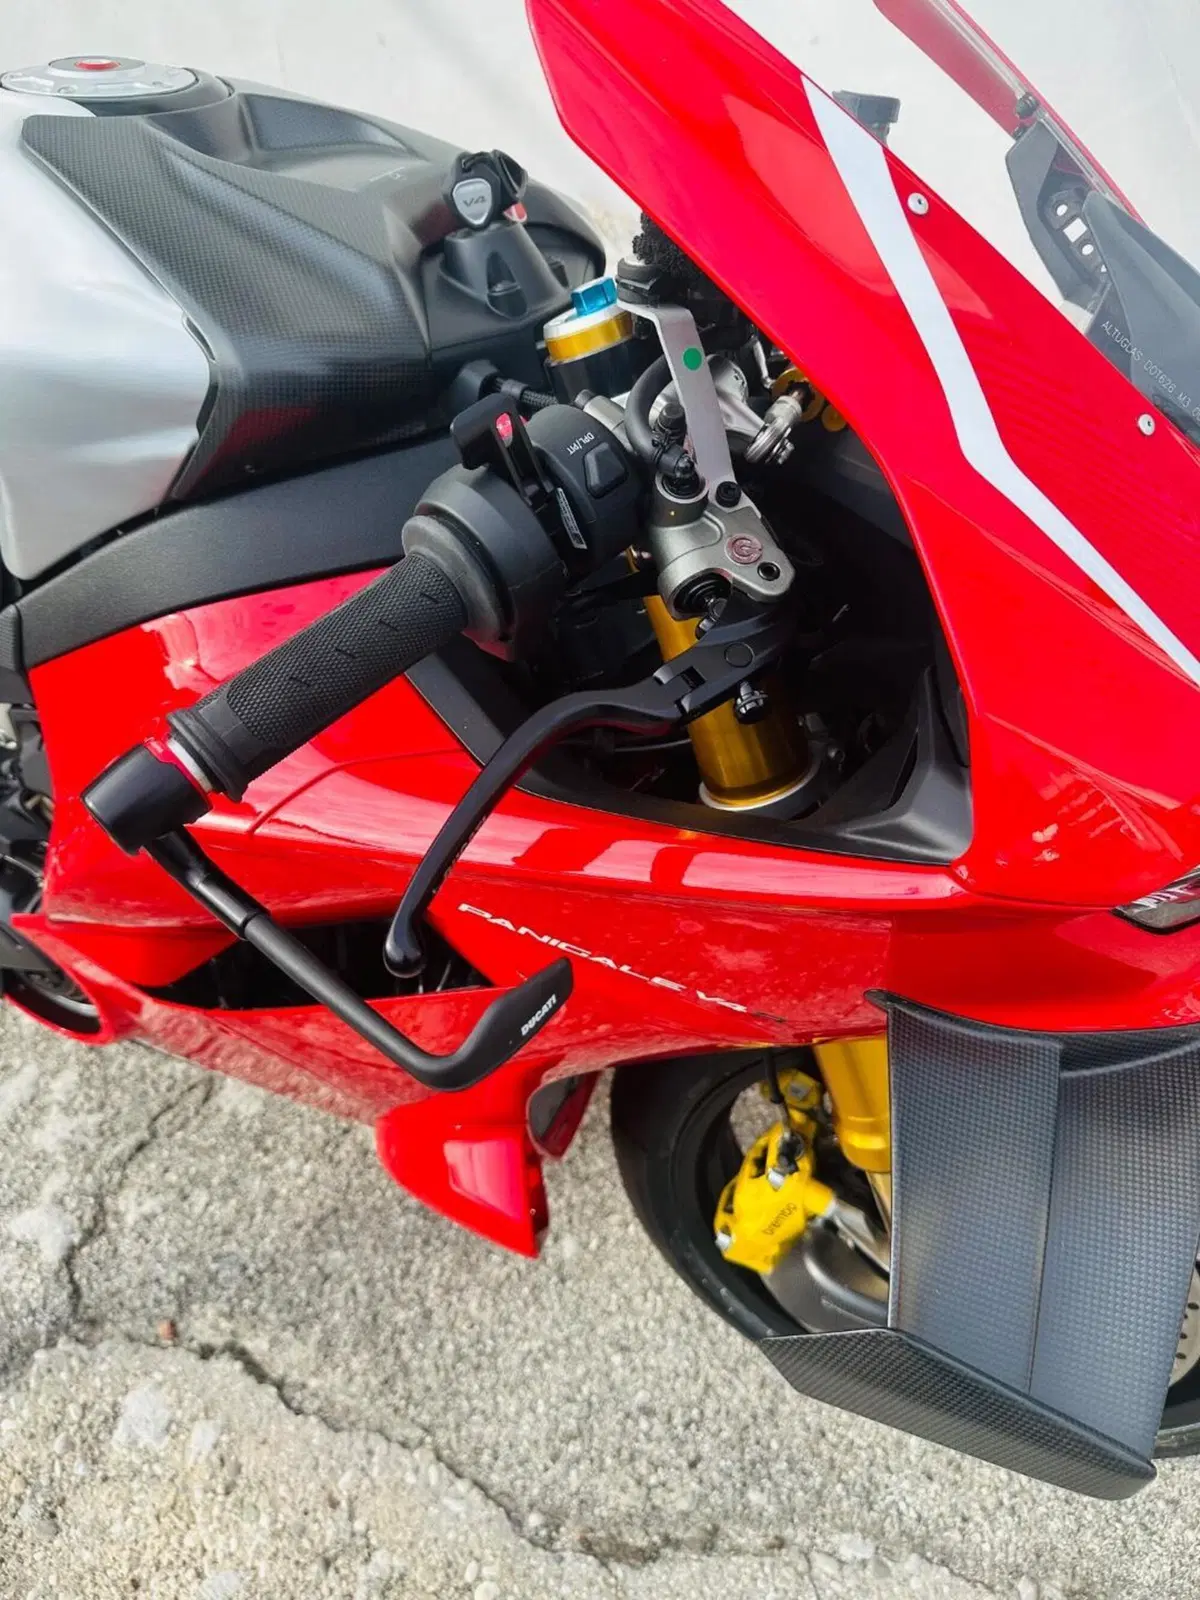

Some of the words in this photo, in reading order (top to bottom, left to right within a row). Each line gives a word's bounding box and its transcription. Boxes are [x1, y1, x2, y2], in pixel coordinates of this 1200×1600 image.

[463, 195, 487, 208] V4
[1101, 320, 1144, 361] ALTUGLAS
[566, 431, 595, 456] DPL/PIT
[457, 903, 688, 993] PANIGALE
[696, 989, 748, 1013] V4
[521, 993, 557, 1036] DUCATI
